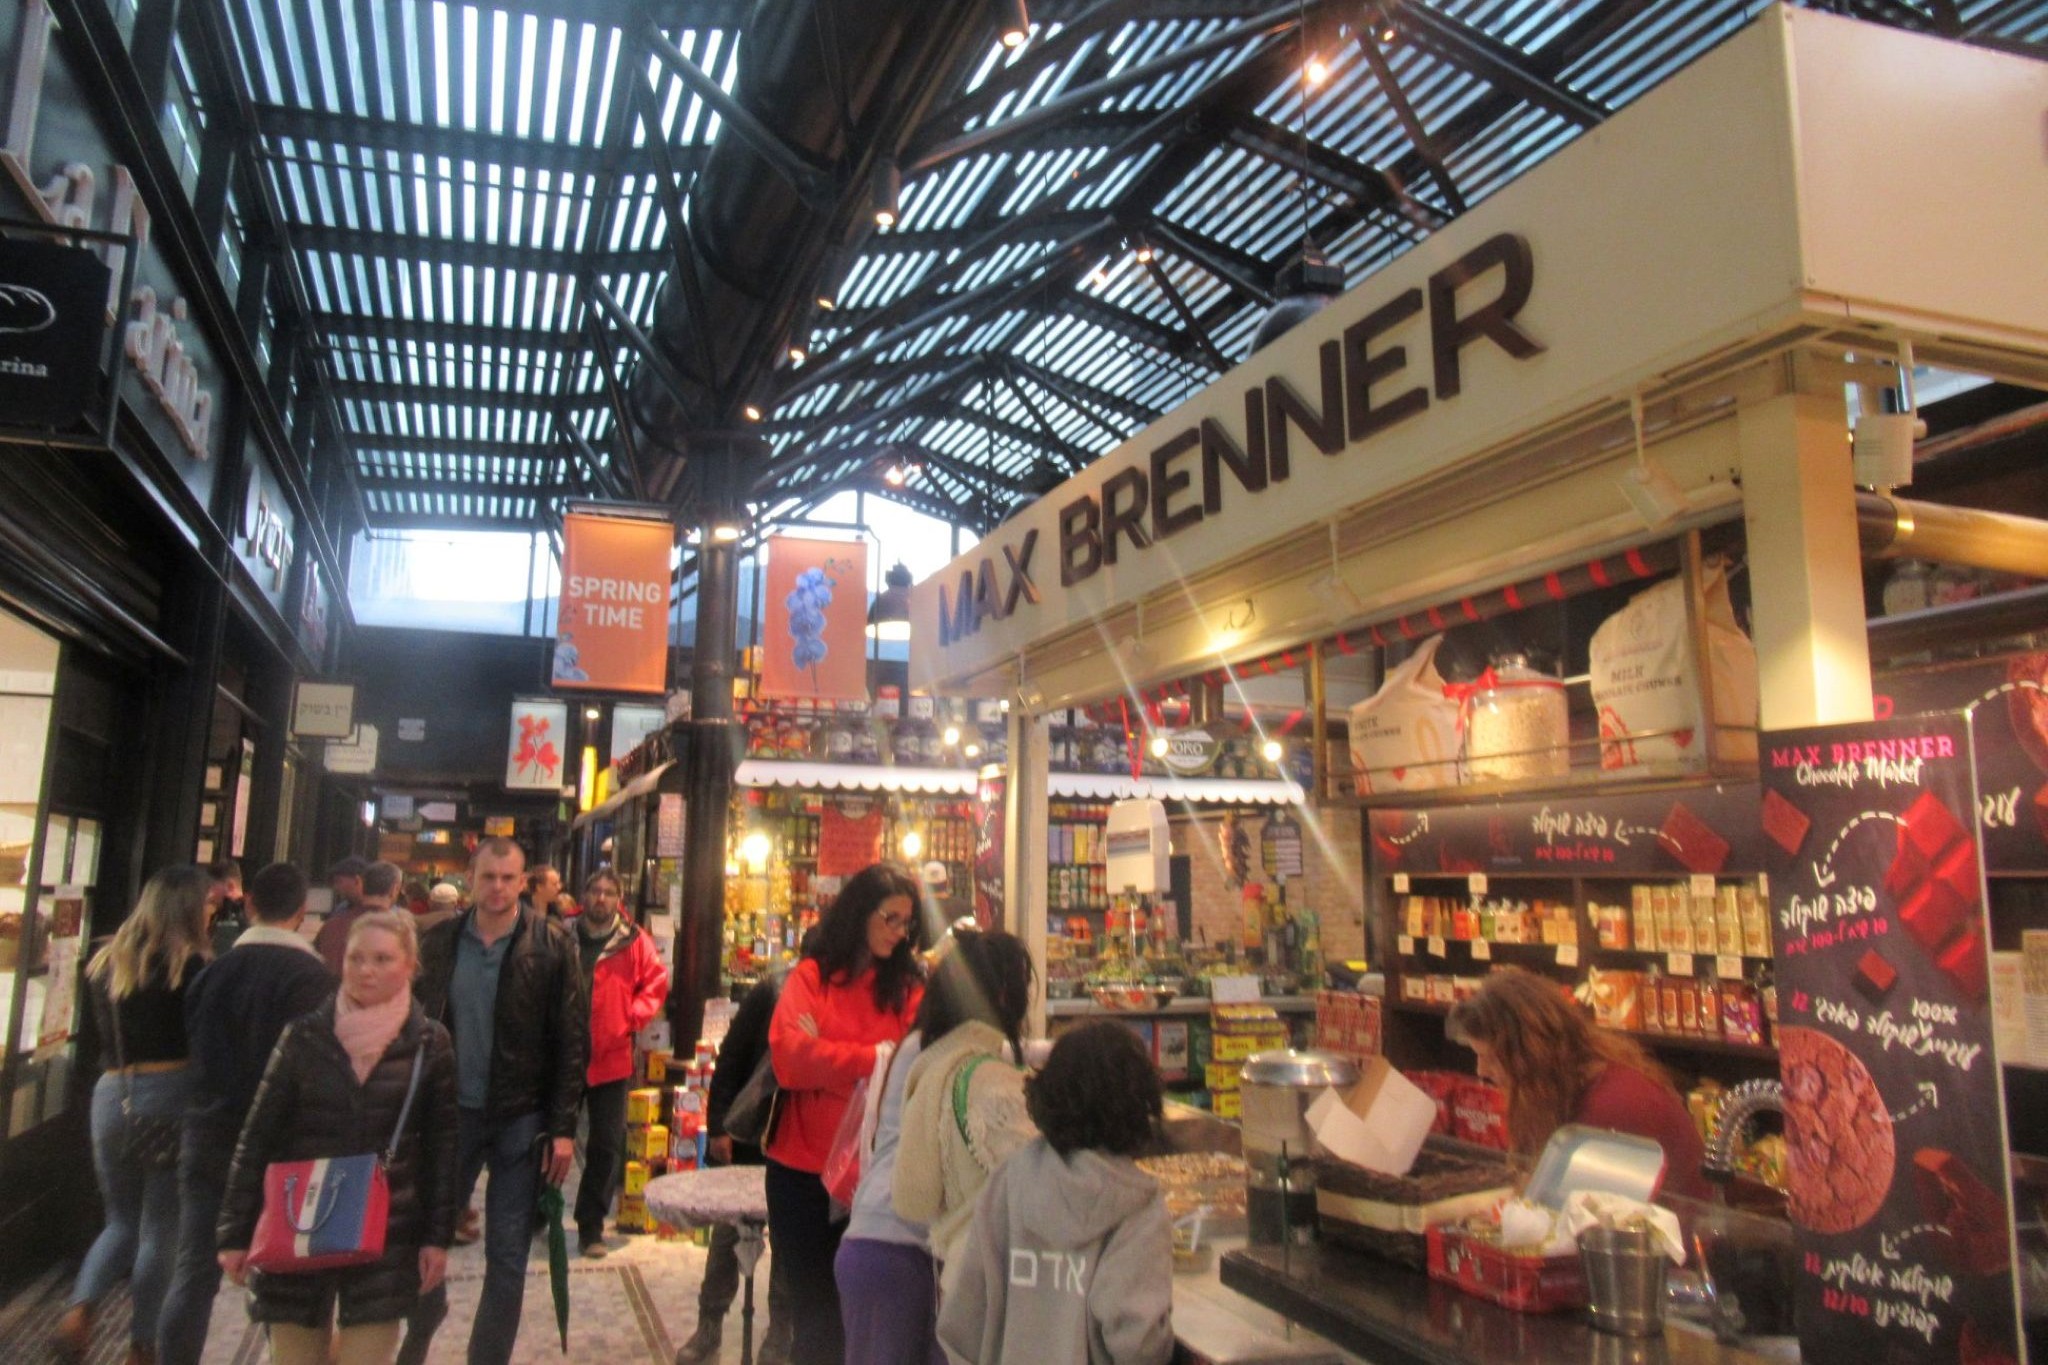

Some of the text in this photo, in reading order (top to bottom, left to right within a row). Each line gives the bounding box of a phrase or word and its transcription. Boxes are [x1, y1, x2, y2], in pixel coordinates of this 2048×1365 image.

[939, 232, 1548, 648] MAX BRENNER
[568, 575, 661, 604] SPRING
[583, 603, 644, 630] TIME
[1771, 735, 1954, 768] MAX BRENNER
[1864, 755, 1924, 790] Market
[1780, 885, 1877, 938] פיצה שוקולד
[1010, 1247, 1086, 1295] אדם
